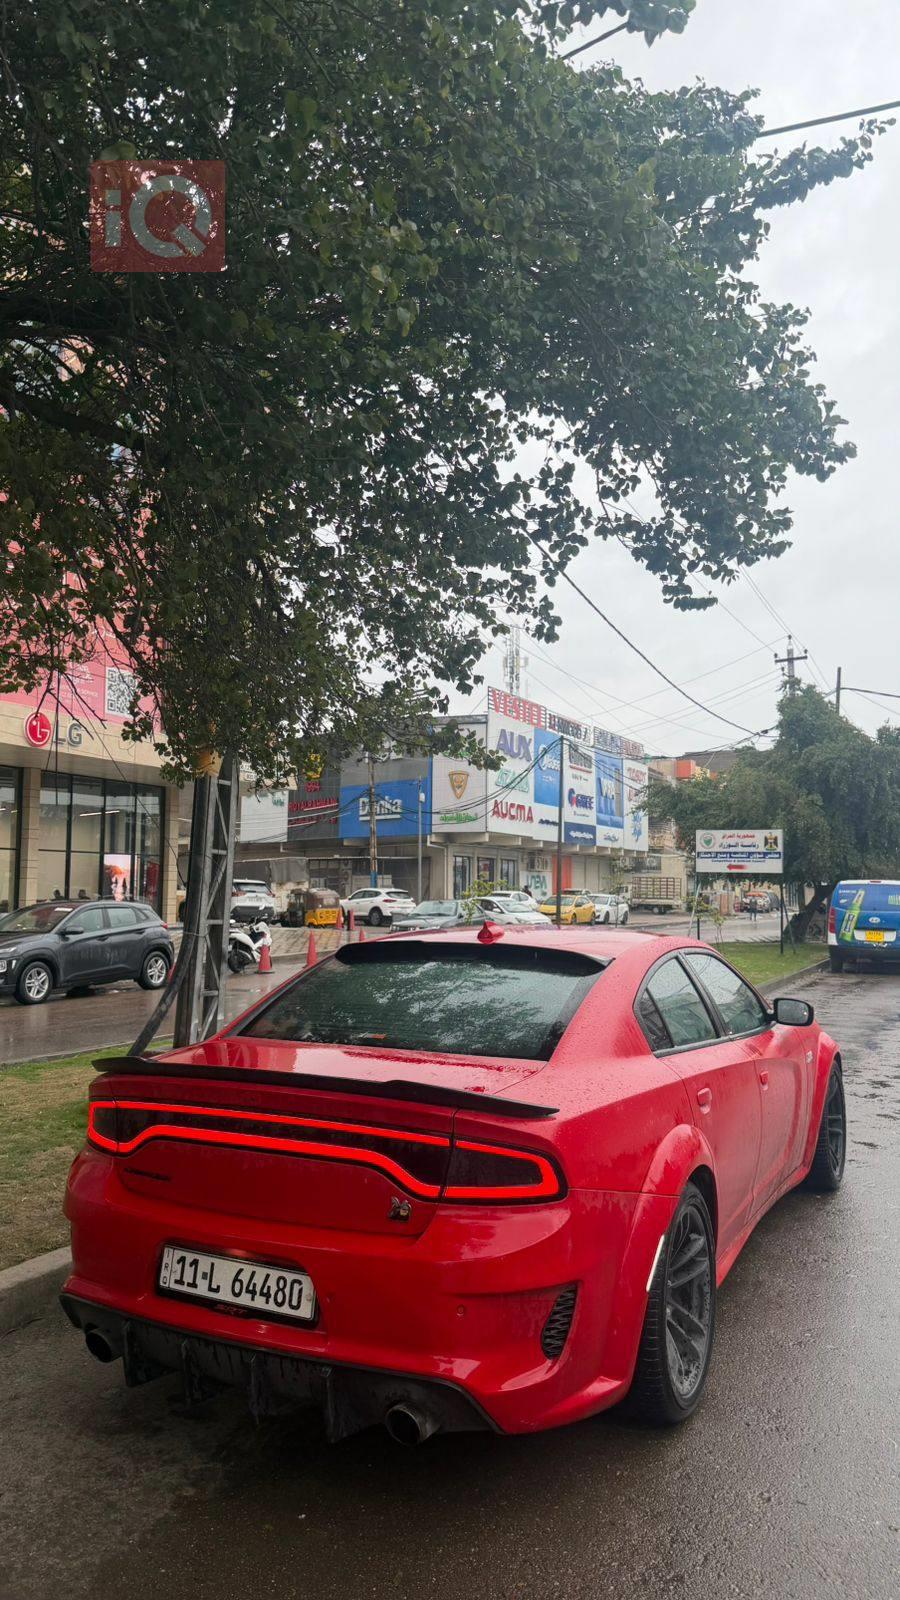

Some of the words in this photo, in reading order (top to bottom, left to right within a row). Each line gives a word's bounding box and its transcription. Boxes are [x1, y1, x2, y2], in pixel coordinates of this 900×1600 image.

[497, 728, 533, 763] AUX
[492, 799, 534, 823] AUCMA
[231, 1267, 304, 1311] 64480
